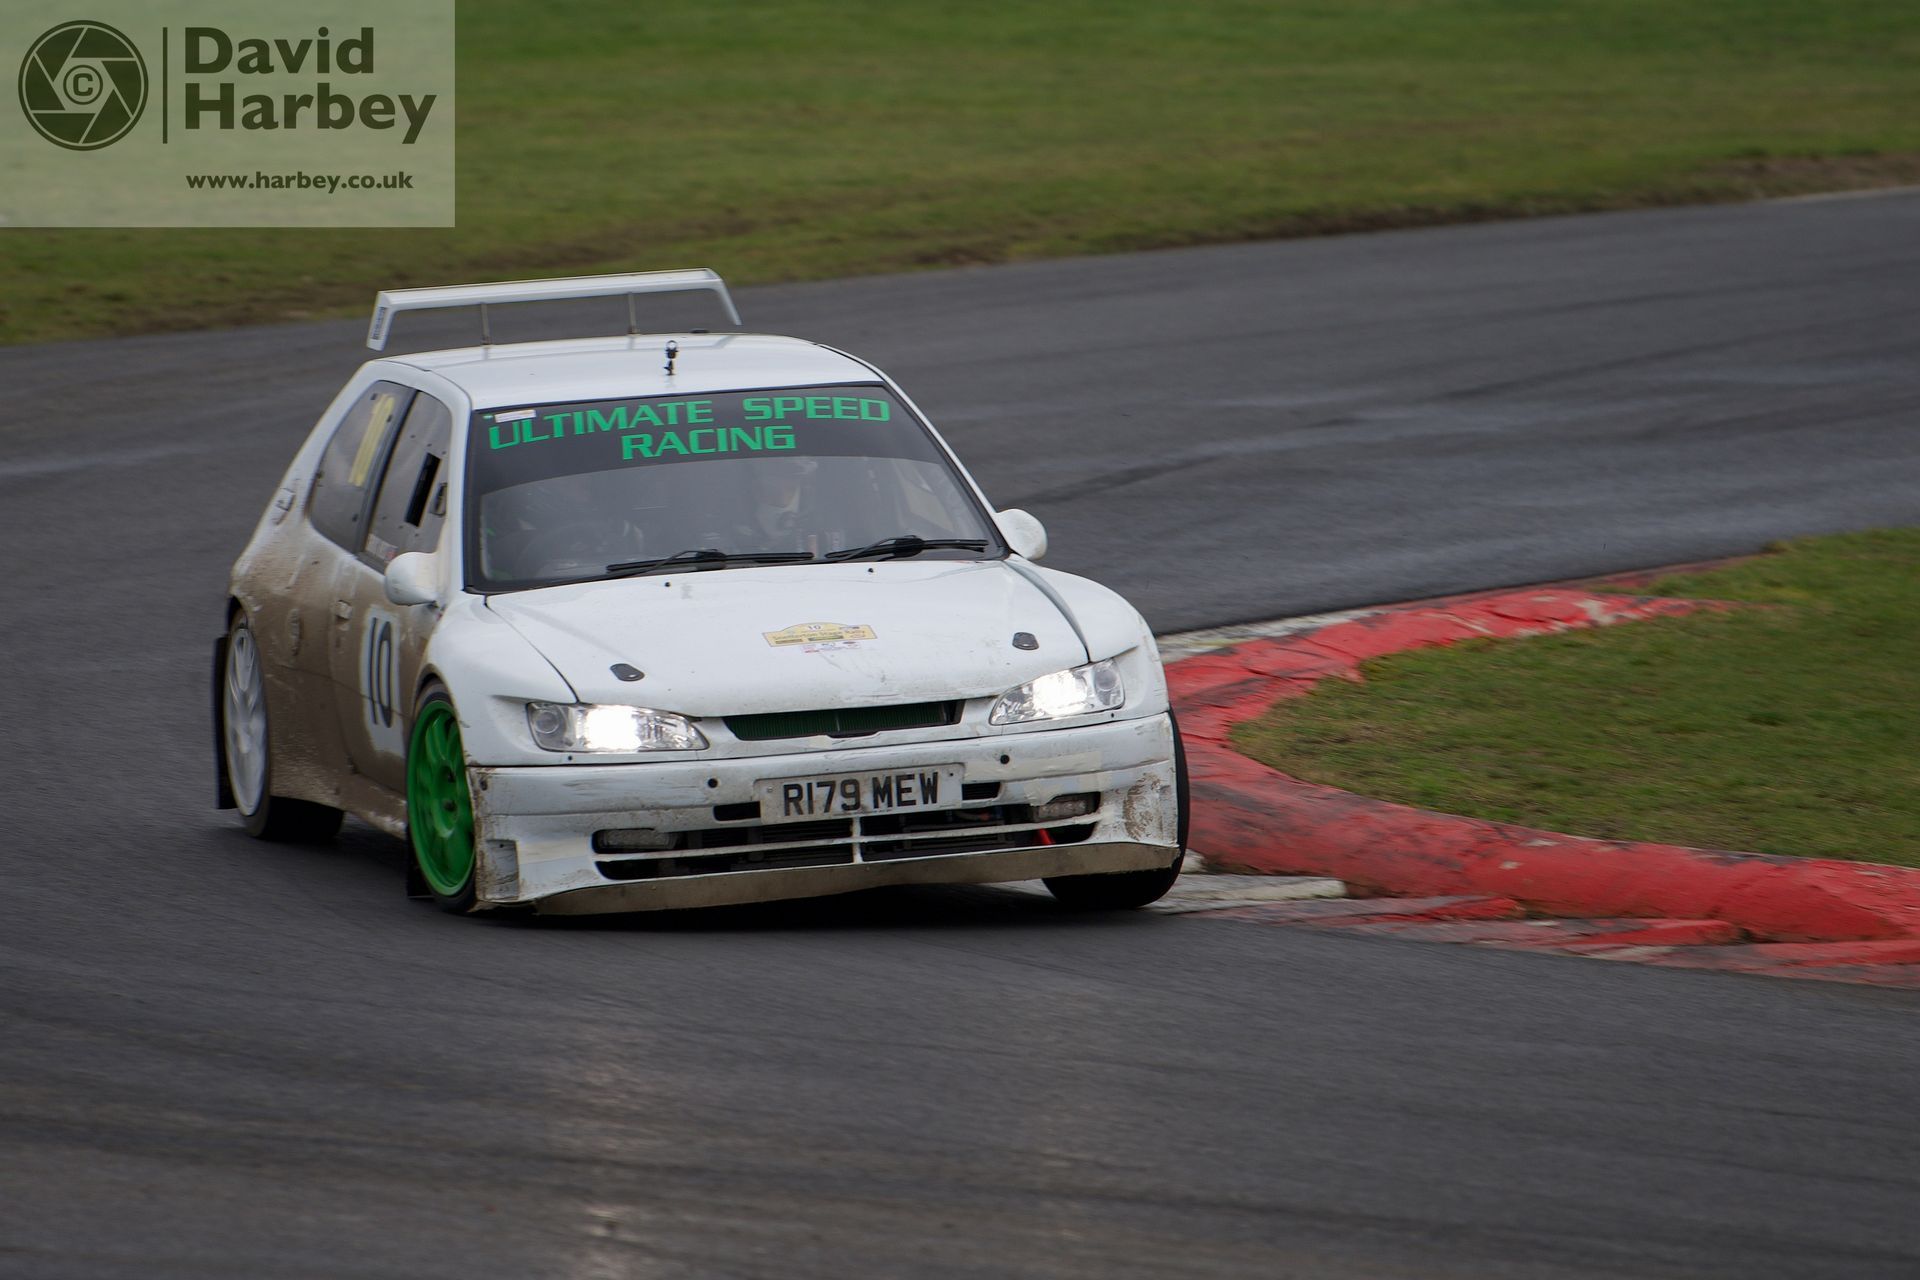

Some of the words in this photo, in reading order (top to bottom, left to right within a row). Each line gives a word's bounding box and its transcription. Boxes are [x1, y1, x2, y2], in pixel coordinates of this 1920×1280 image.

[488, 400, 714, 450] ULTIMATE
[743, 396, 891, 422] SPEED
[621, 425, 796, 460] RACING
[368, 616, 393, 729] 10
[783, 778, 861, 817] R179
[872, 771, 939, 809] MEW
